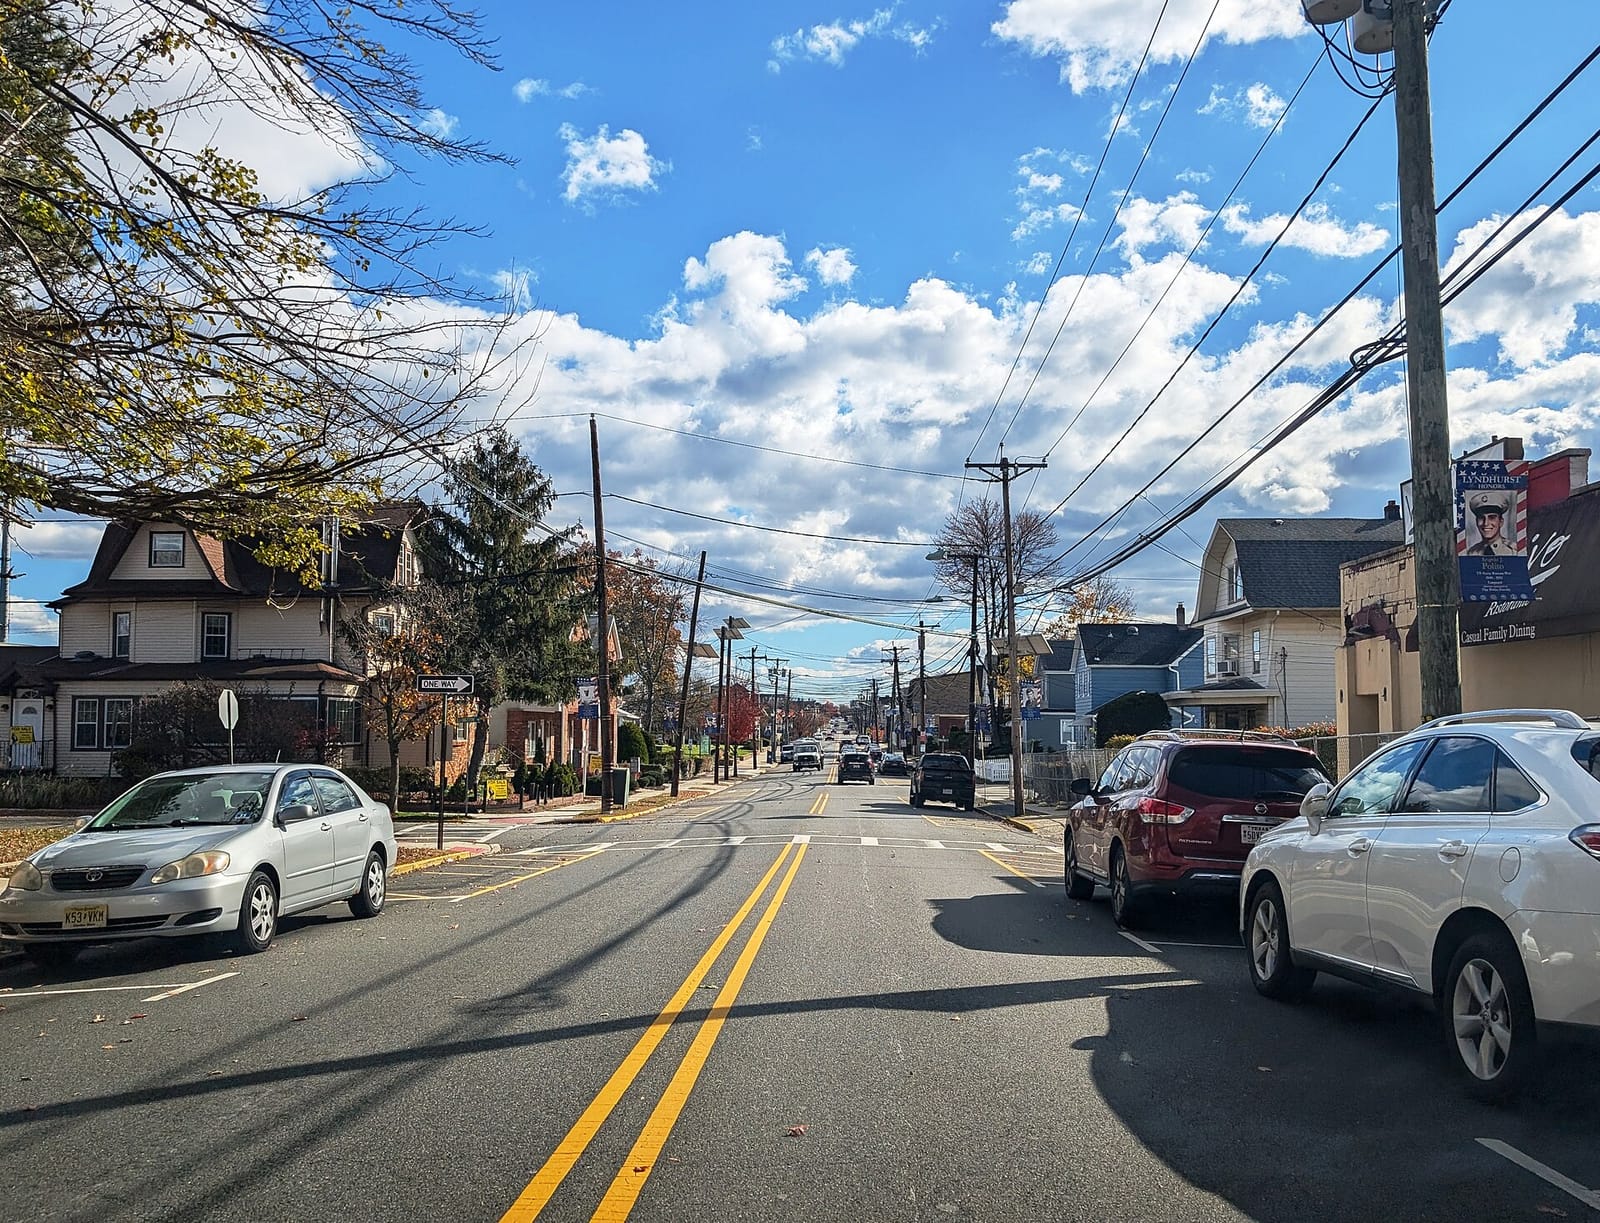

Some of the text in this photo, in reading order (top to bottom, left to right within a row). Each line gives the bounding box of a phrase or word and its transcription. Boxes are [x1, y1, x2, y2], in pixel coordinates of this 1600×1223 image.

[1462, 475, 1521, 484] LYNDHURST
[1461, 622, 1536, 644] Casual Family Dining
[423, 680, 456, 688] ONE WAY
